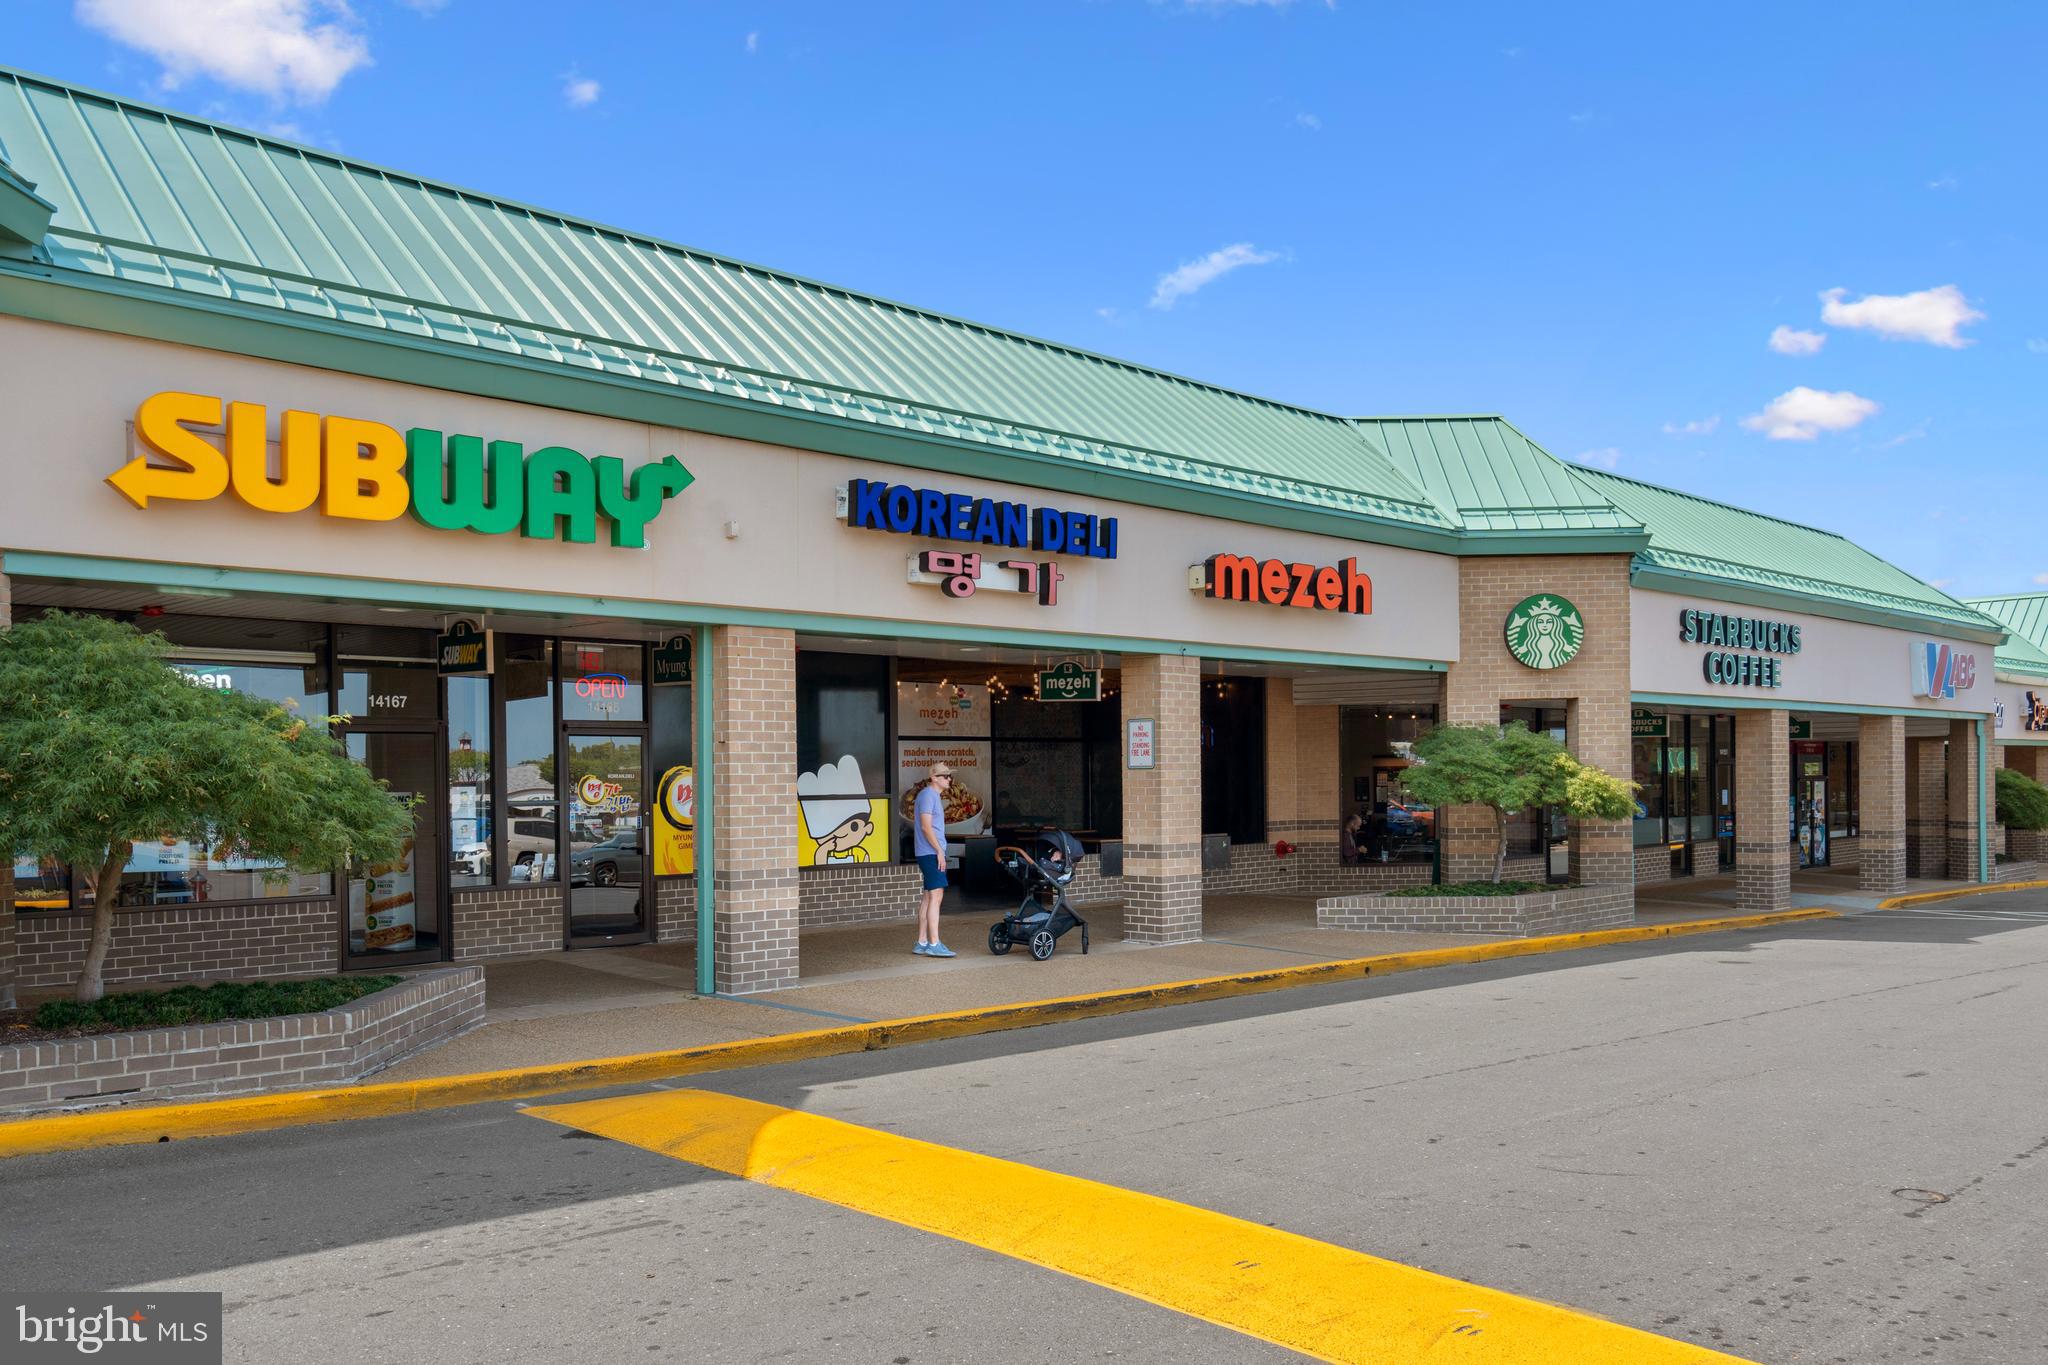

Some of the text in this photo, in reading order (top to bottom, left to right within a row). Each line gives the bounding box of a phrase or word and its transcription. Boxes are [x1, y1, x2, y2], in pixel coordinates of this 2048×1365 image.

[105, 391, 695, 548] SUBWAY
[848, 479, 1118, 559] KOREAN DELI
[1206, 553, 1373, 615] mezeh
[1680, 608, 1801, 655] STARBUCKS
[441, 642, 483, 665] SUBWAY
[656, 660, 686, 677] Myung
[1703, 650, 1782, 688] COFFEE
[1947, 653, 1977, 690] ABC
[575, 678, 625, 699] OPEN
[1046, 674, 1091, 690] mezeh
[368, 695, 408, 708] 14167
[919, 707, 959, 720] mezeh
[903, 747, 926, 756] made
[927, 747, 946, 756] from
[959, 758, 977, 767] food
